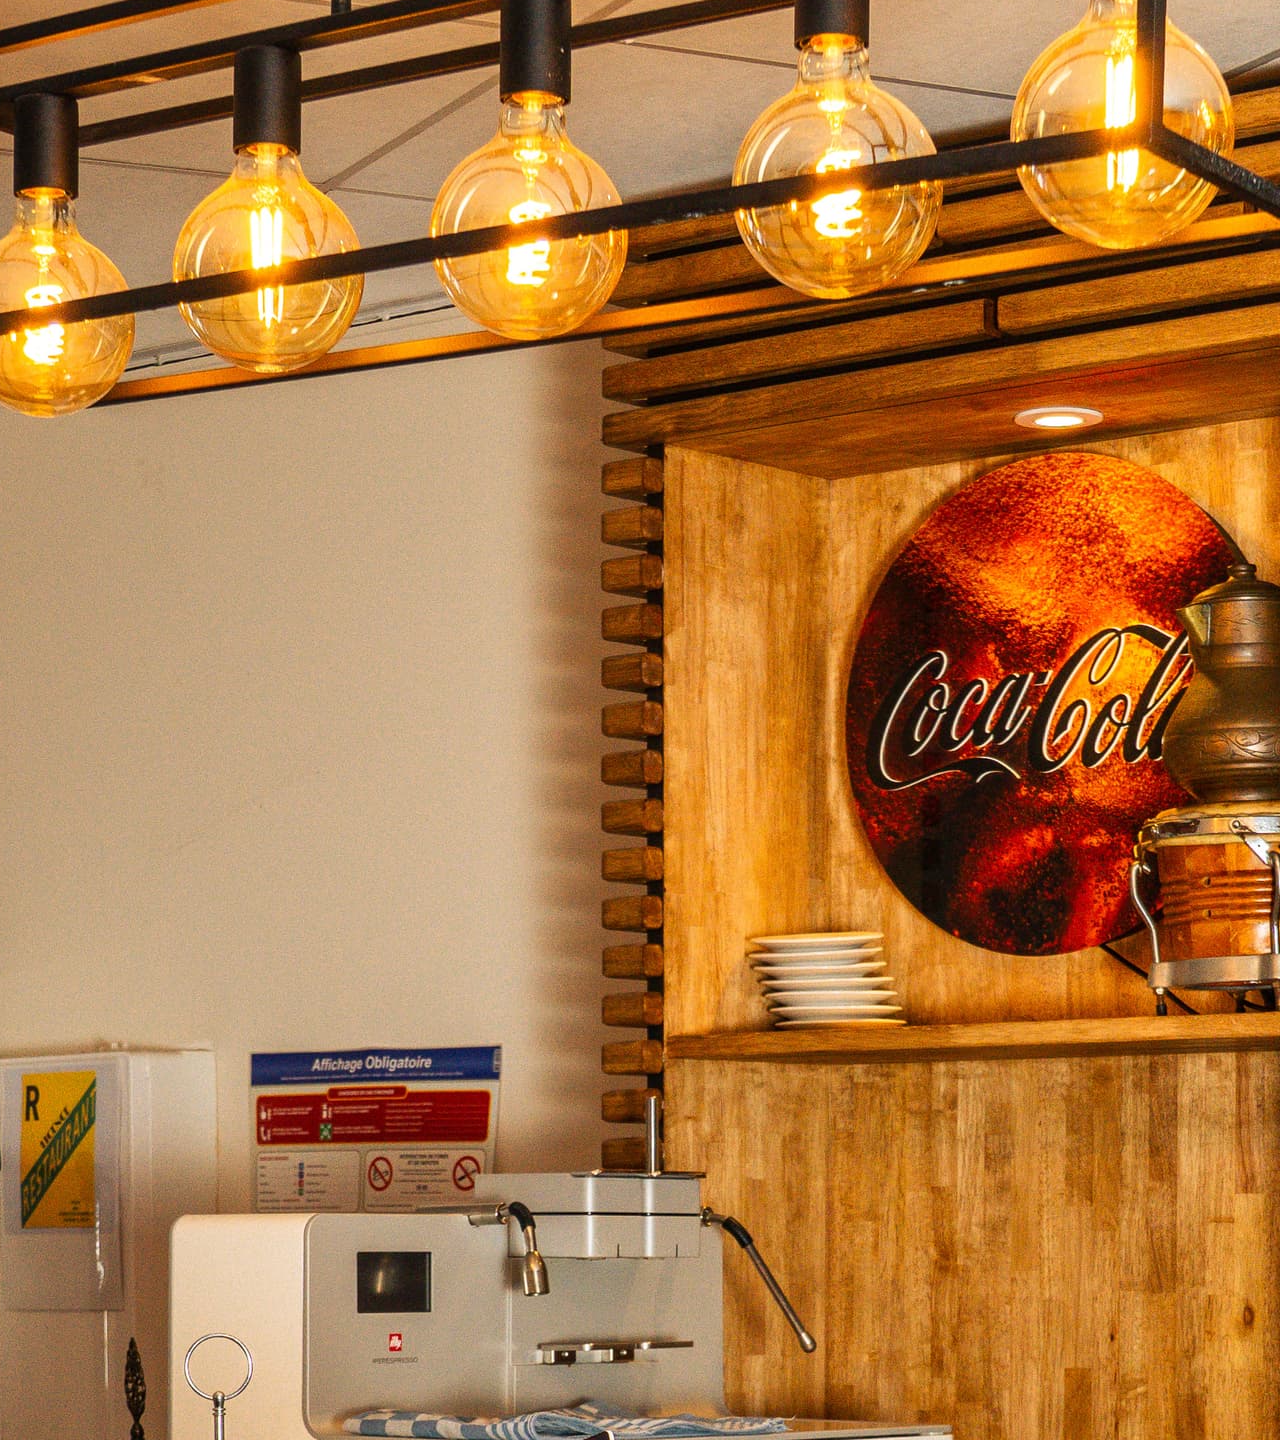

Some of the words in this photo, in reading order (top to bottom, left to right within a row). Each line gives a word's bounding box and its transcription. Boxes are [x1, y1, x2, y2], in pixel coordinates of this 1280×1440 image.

[312, 1058, 363, 1072] Affichage
[365, 1056, 432, 1070] Obligatoire
[25, 1085, 40, 1121] R
